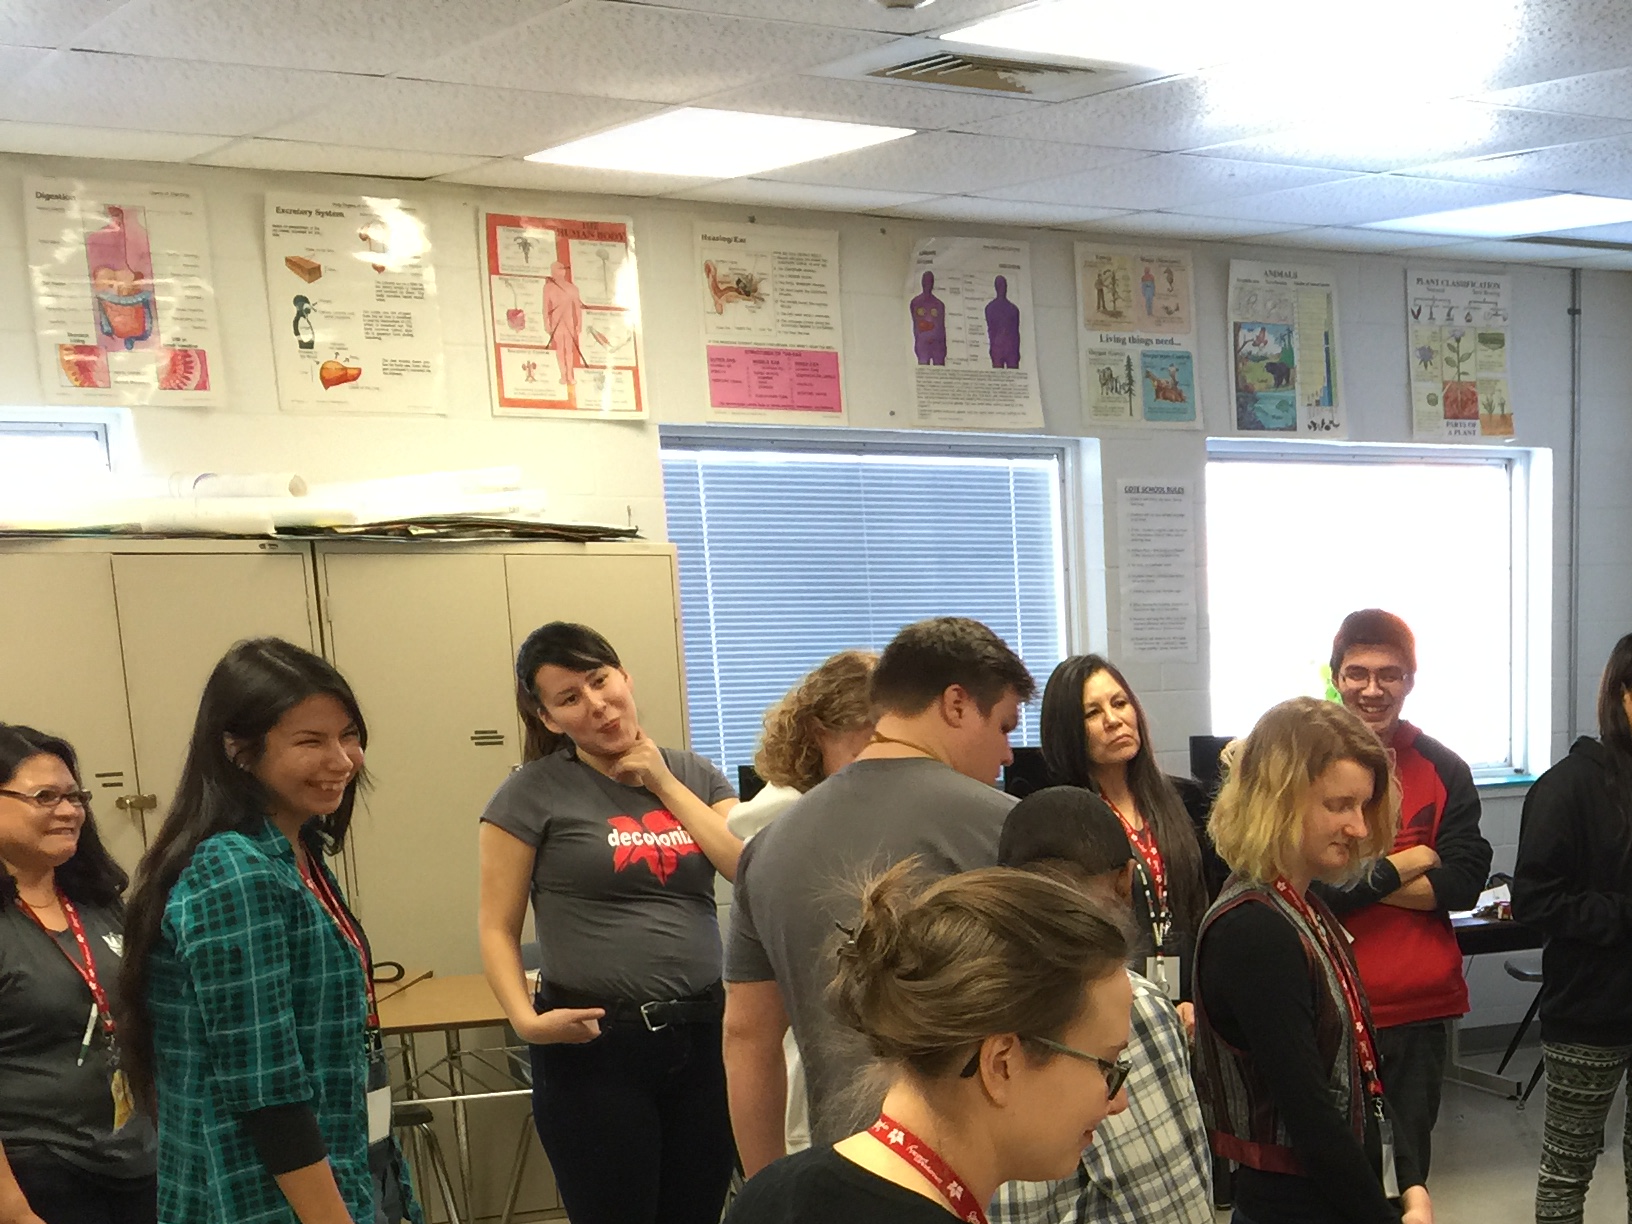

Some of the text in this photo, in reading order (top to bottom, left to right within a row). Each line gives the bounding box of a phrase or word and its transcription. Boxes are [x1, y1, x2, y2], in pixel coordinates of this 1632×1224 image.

[35, 191, 76, 201] Digestion
[275, 206, 345, 219] Excretory System
[556, 228, 626, 241] HUMAN BODY
[1263, 269, 1298, 279] ANIMALS
[1416, 277, 1500, 289] PLANT CLASSIFICATION
[1099, 333, 1127, 346] Living
[1128, 335, 1154, 346] things
[1141, 486, 1166, 495] SCHOOL
[1166, 486, 1185, 495] RULES
[607, 826, 694, 848] decoloniz
